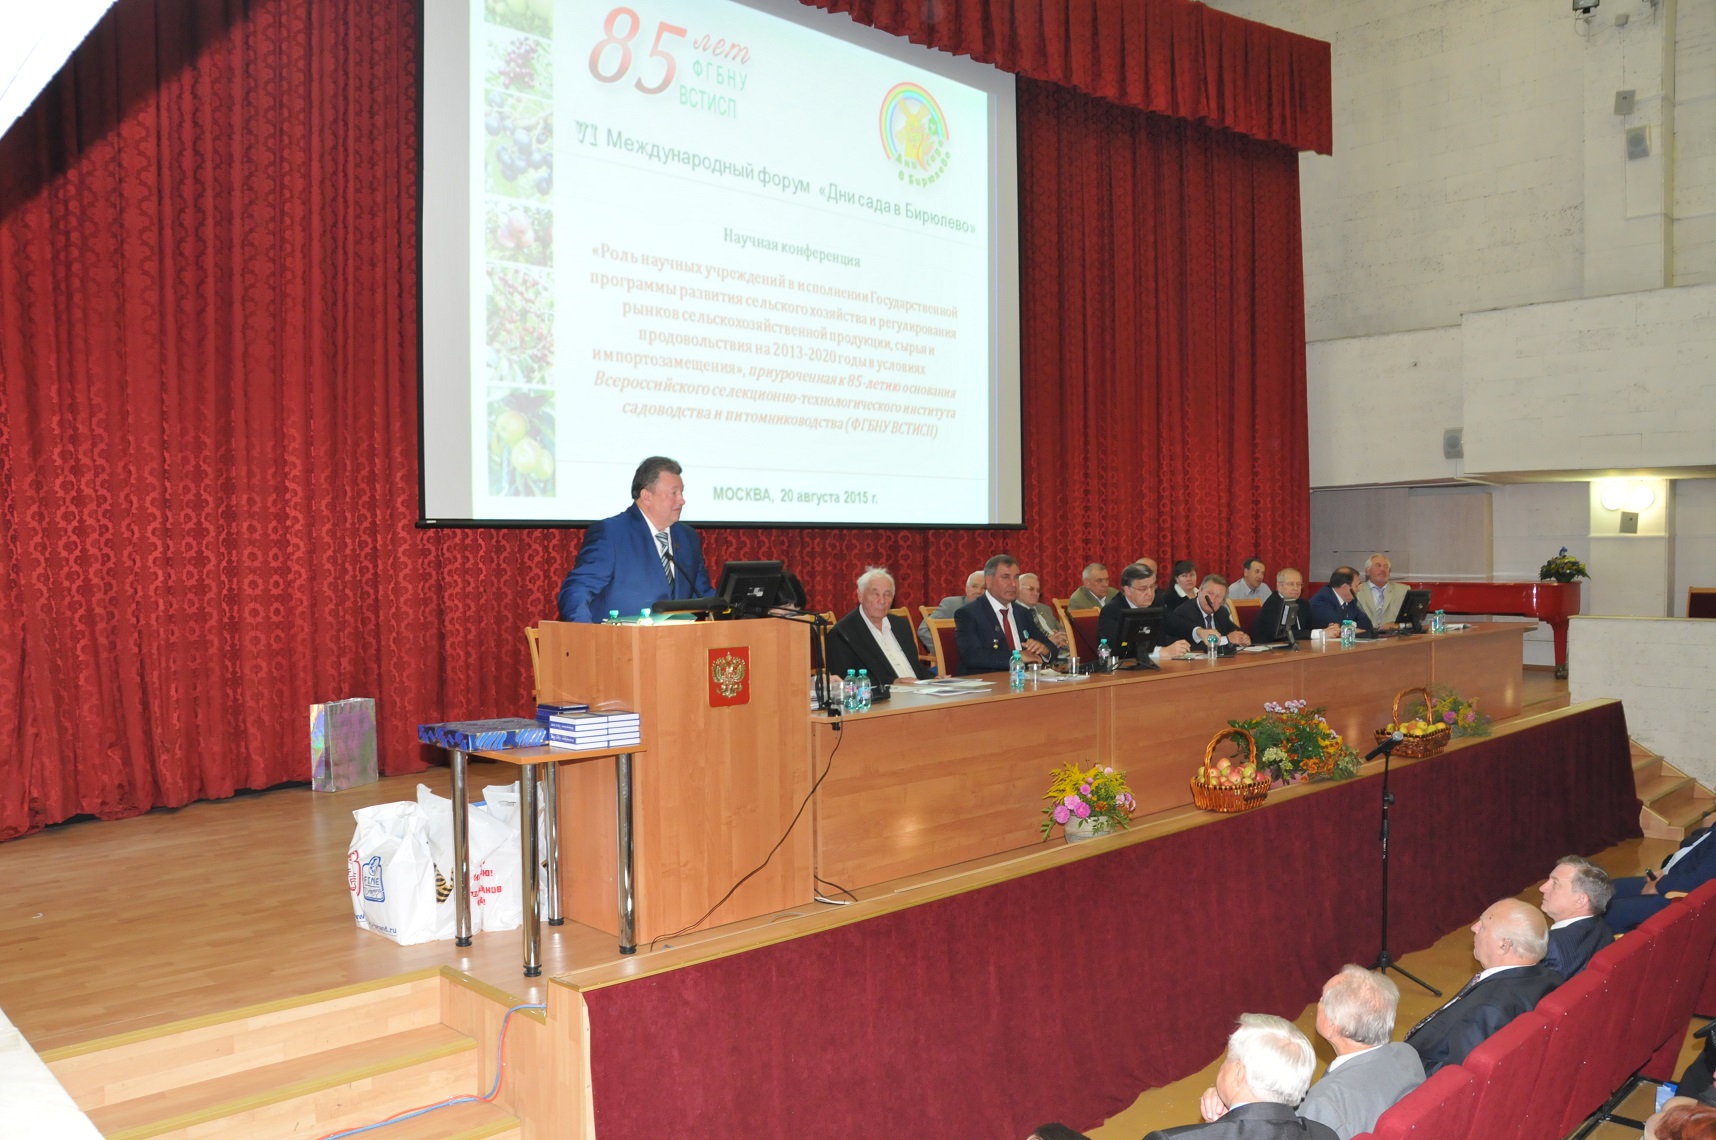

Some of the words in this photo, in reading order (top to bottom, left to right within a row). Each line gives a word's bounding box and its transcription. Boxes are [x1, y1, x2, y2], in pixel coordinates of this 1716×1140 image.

[588, 6, 688, 95] 85
[692, 33, 751, 65] лет
[692, 59, 748, 91] ФГБНУ
[678, 84, 737, 119] ВСТИСП
[606, 127, 755, 180] Международный
[757, 165, 811, 196] форум
[818, 182, 856, 205] «Дни
[857, 193, 892, 216] сада
[893, 204, 902, 216] в
[904, 202, 977, 235] Бирюлево»
[723, 226, 780, 252] Научная
[780, 241, 862, 268] конференция
[590, 271, 677, 296] программы
[679, 285, 744, 306] развития
[744, 296, 808, 317] сельского
[808, 304, 868, 326] хозяйства
[868, 314, 876, 327] и
[878, 316, 957, 339] регулирования
[592, 242, 639, 264] «Роль
[641, 253, 703, 275] научных
[704, 264, 786, 289] учреждений
[788, 278, 796, 290] в
[797, 281, 869, 304] исполнении
[869, 290, 958, 319] Государственной
[622, 301, 680, 320] рынков
[681, 309, 827, 341] сельскохозяйственной
[828, 330, 894, 351] продукции,
[894, 341, 927, 357] сырья
[928, 347, 935, 357] и
[638, 328, 752, 354] продовольствия
[754, 342, 771, 356] на
[773, 341, 837, 364] 2013-2020
[837, 354, 867, 369] годы
[868, 359, 875, 369] в
[875, 359, 927, 376] условиях
[592, 348, 747, 378] импортозамещения»,
[749, 364, 838, 386] приуроченная
[838, 374, 847, 386] к
[847, 373, 901, 393] 85-летию
[902, 382, 957, 399] основания
[594, 369, 711, 396] Всероссийского
[711, 384, 901, 414] селекционно-технологического
[901, 402, 957, 421] института
[622, 401, 712, 420] садоводства
[713, 408, 723, 421] и
[725, 410, 844, 433] питомниководства
[844, 415, 891, 434] (ФГБНУ
[890, 419, 939, 440] ВСТИСП)
[712, 485, 775, 505] МОСКВА,
[780, 488, 794, 503] 20
[796, 490, 840, 507] августа
[843, 489, 869, 505] 2015
[871, 494, 879, 505] г.
